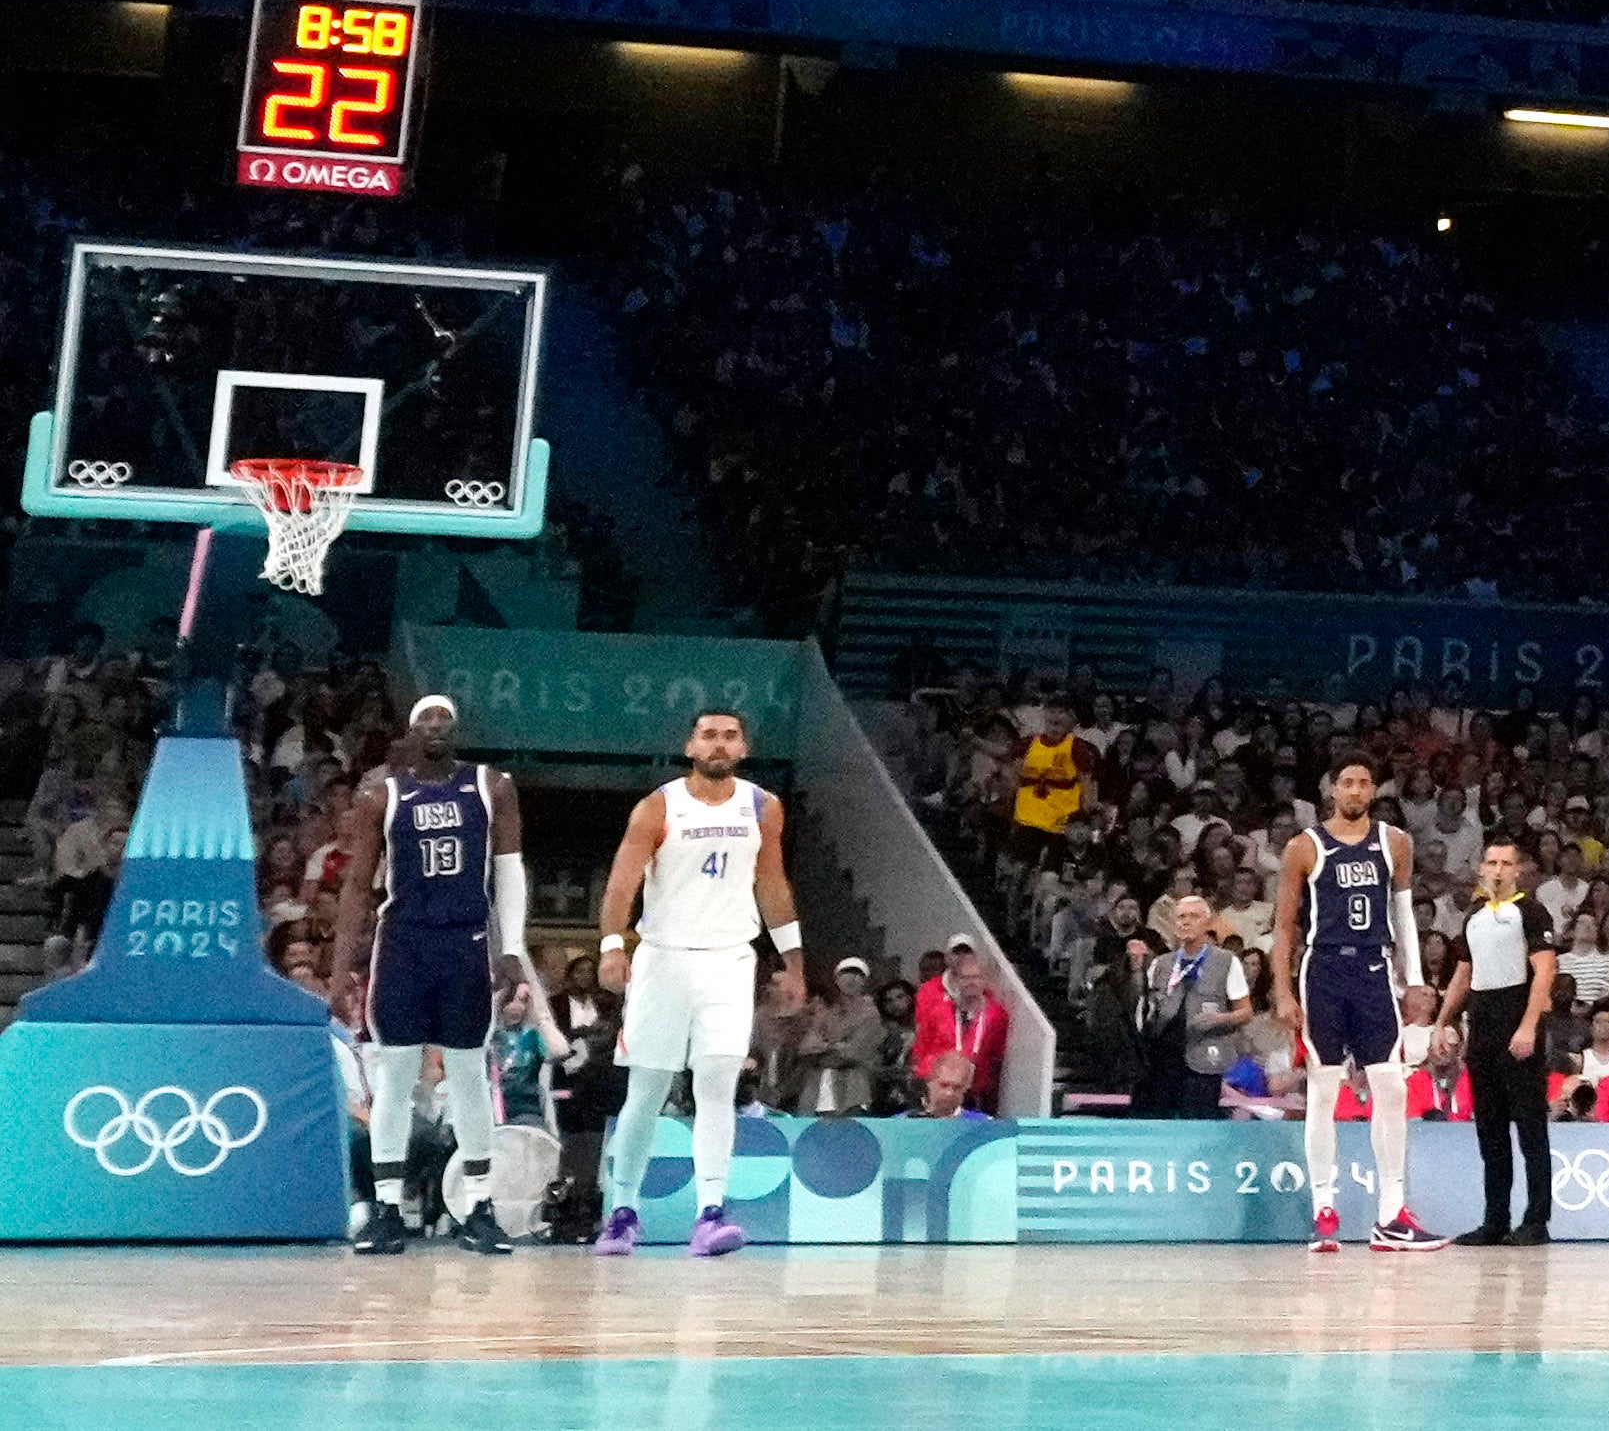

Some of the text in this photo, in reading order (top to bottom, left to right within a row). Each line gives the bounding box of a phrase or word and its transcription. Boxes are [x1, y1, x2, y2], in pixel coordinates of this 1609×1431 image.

[297, 4, 410, 56] 8:58
[262, 61, 391, 147] 22
[283, 161, 390, 192] OMEGA
[413, 800, 464, 831] USA
[419, 836, 464, 877] 13
[701, 851, 728, 879] 41
[1335, 861, 1380, 889] USA
[130, 899, 243, 927] PARIS
[1348, 893, 1371, 930] 9
[127, 930, 239, 958] 2024
[1053, 1161, 1211, 1195] PARIS
